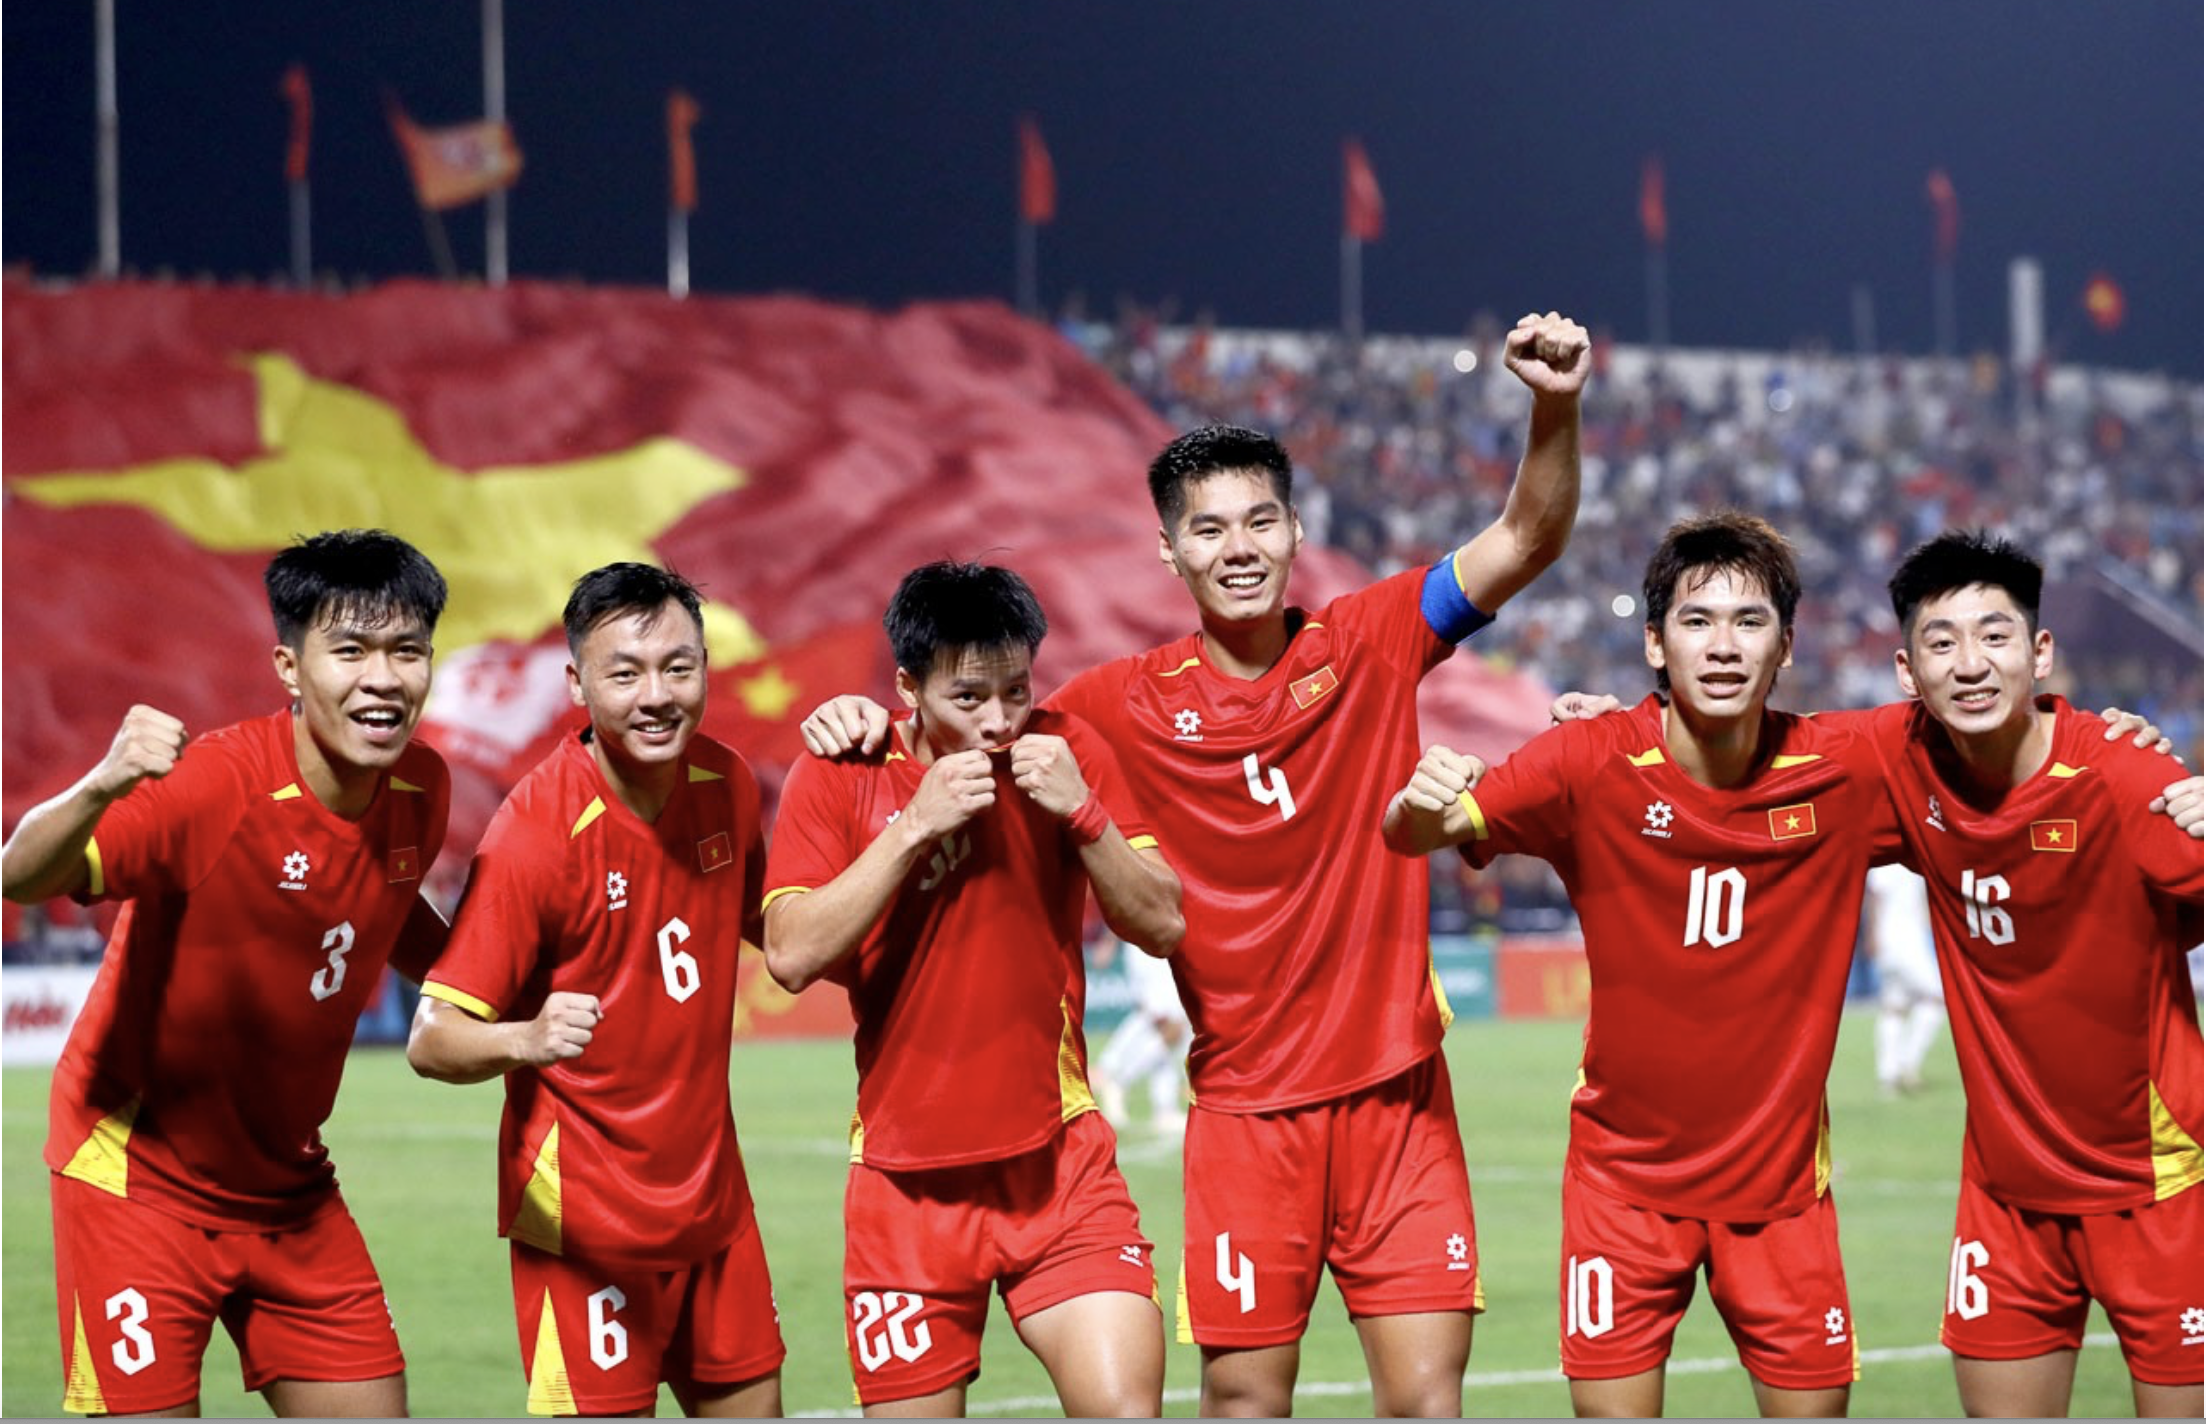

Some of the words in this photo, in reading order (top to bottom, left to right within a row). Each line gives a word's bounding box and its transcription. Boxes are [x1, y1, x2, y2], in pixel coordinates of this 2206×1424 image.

[1241, 752, 1297, 822] 4
[1683, 865, 1747, 949] 10
[1961, 869, 2016, 946] 16
[309, 921, 355, 1001] 3
[656, 916, 701, 1004] 6
[1215, 1230, 1256, 1314] 4
[1566, 1254, 1614, 1340] 10
[1946, 1235, 1990, 1321] 16
[104, 1286, 156, 1376] 3
[587, 1286, 629, 1371] 6
[852, 1290, 933, 1373] 22
